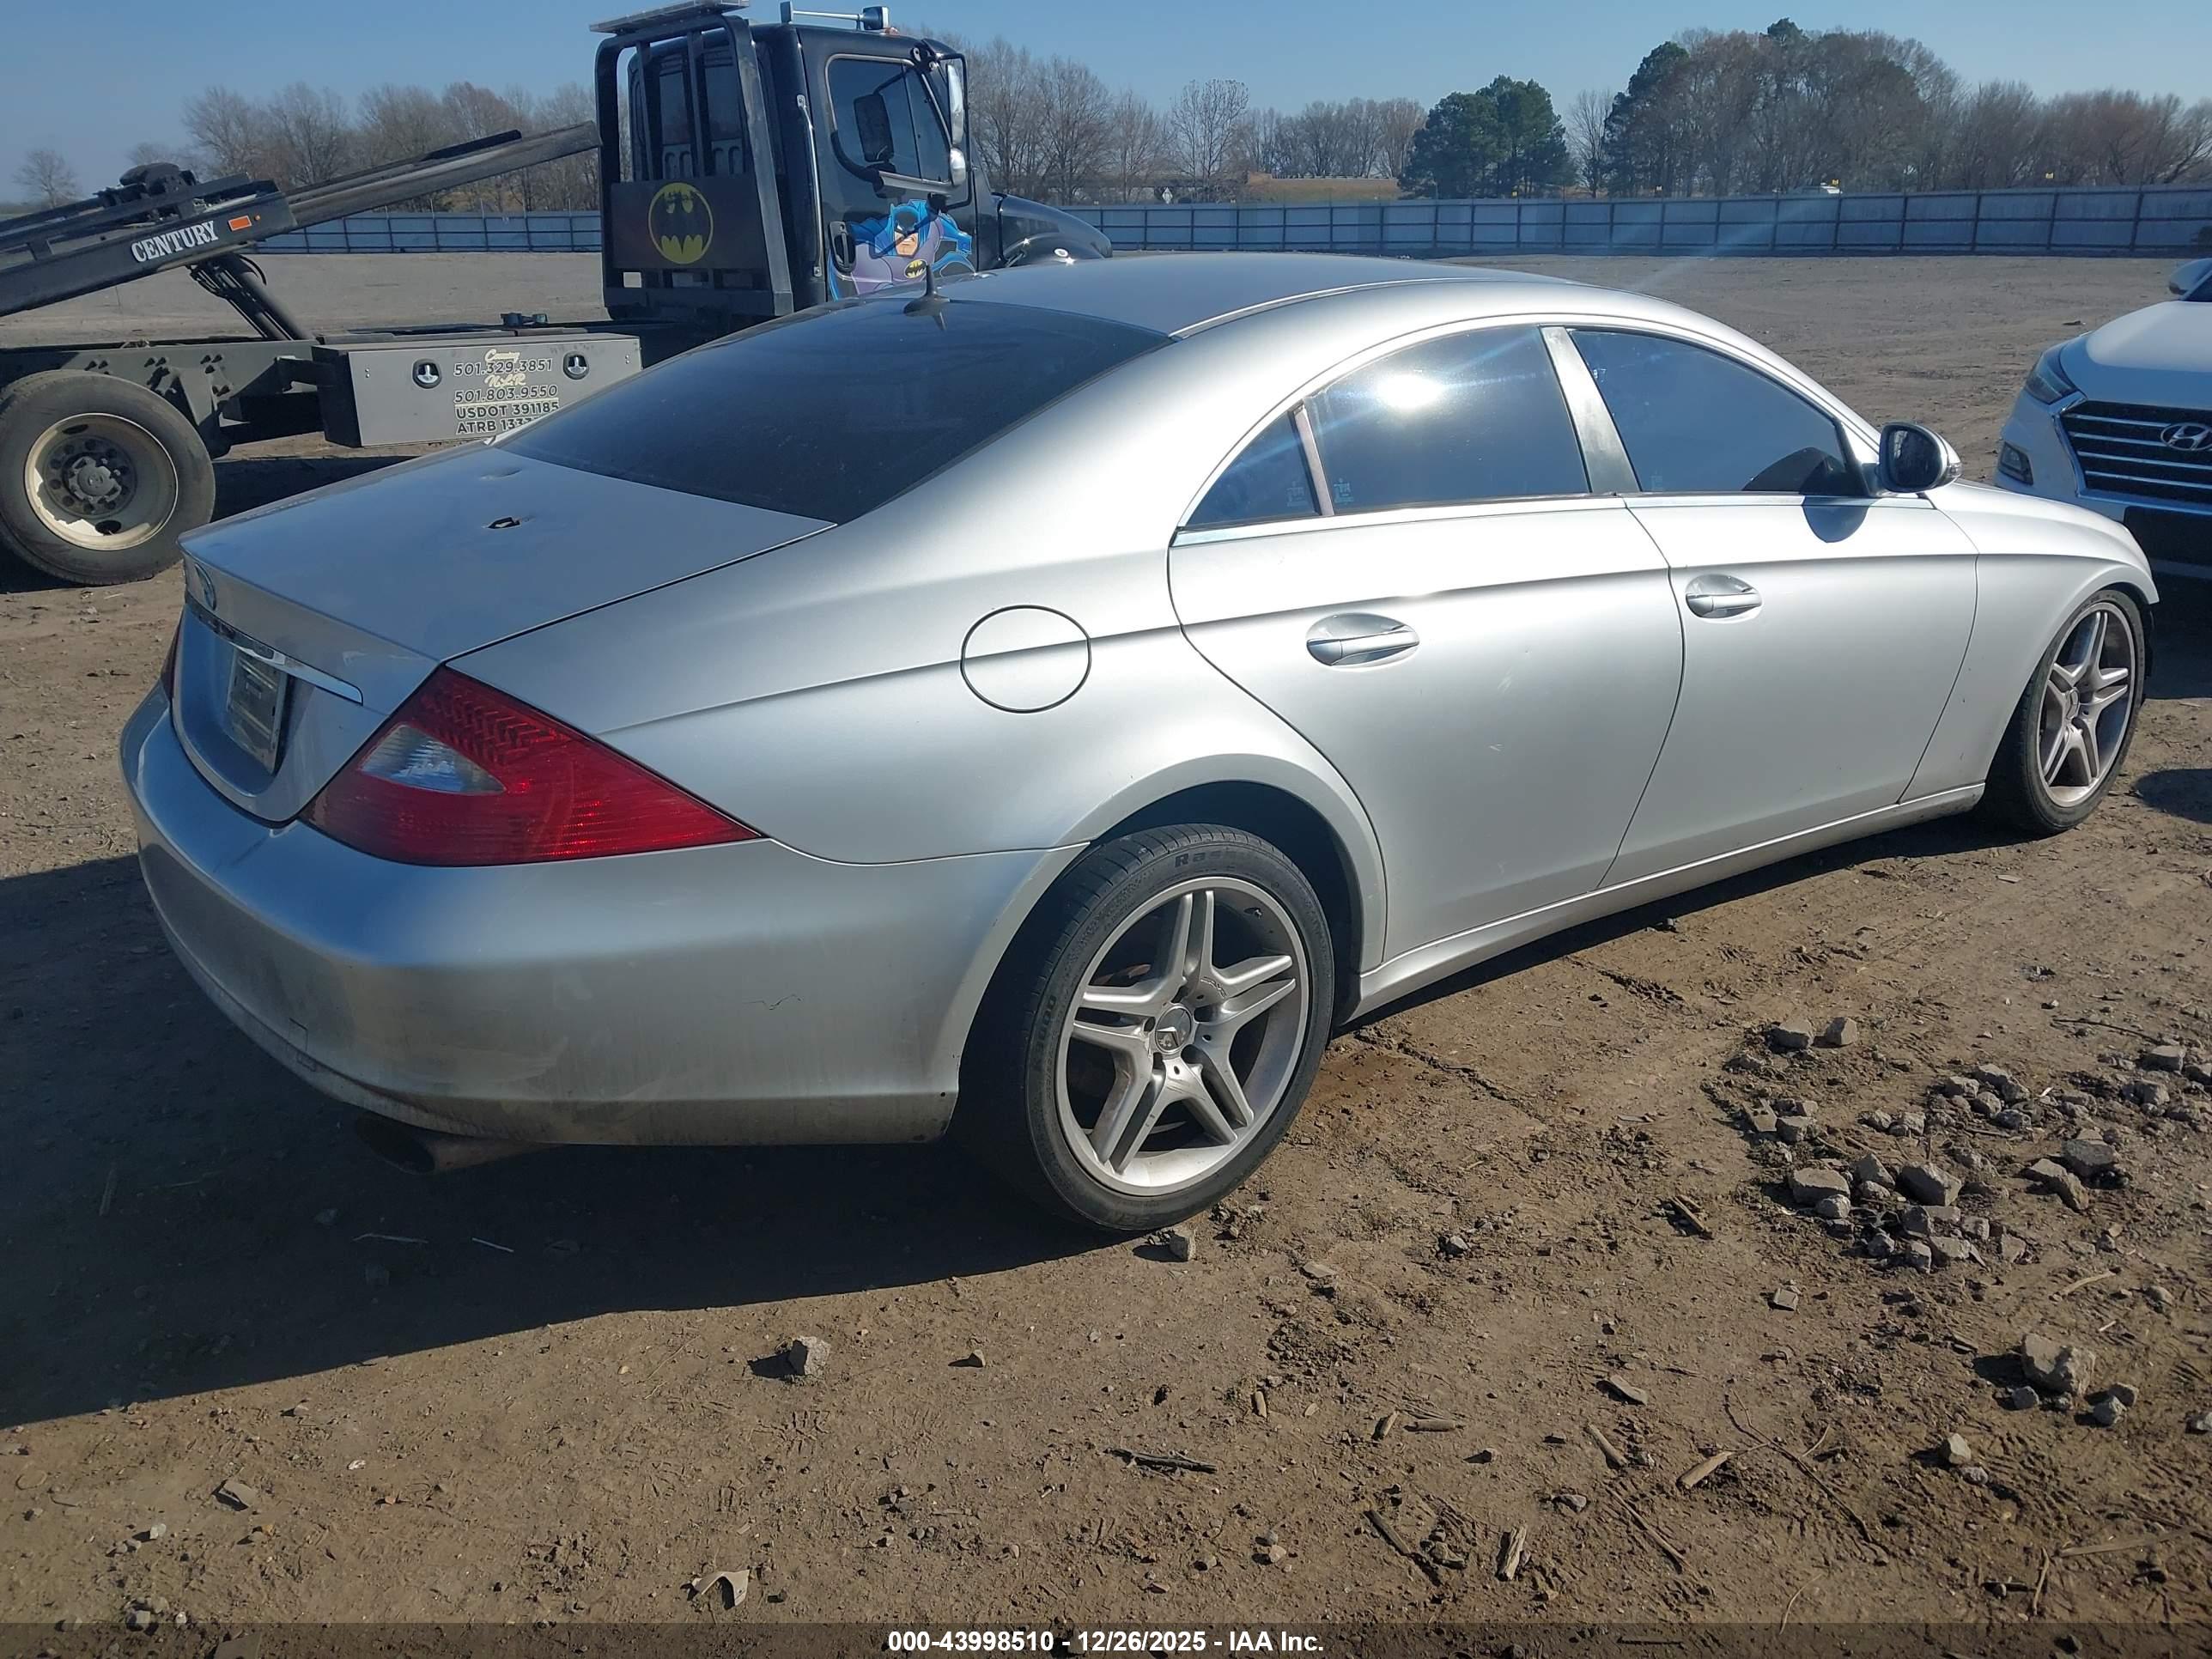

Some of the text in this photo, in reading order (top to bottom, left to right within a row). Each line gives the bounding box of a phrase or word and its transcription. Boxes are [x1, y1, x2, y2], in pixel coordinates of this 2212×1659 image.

[131, 221, 218, 262] CENTURY
[453, 358, 553, 376] 501.329.3851
[454, 385, 558, 404] 501.803.9550
[456, 401, 559, 419] USDOT 391185
[456, 420, 496, 434] ATRB
